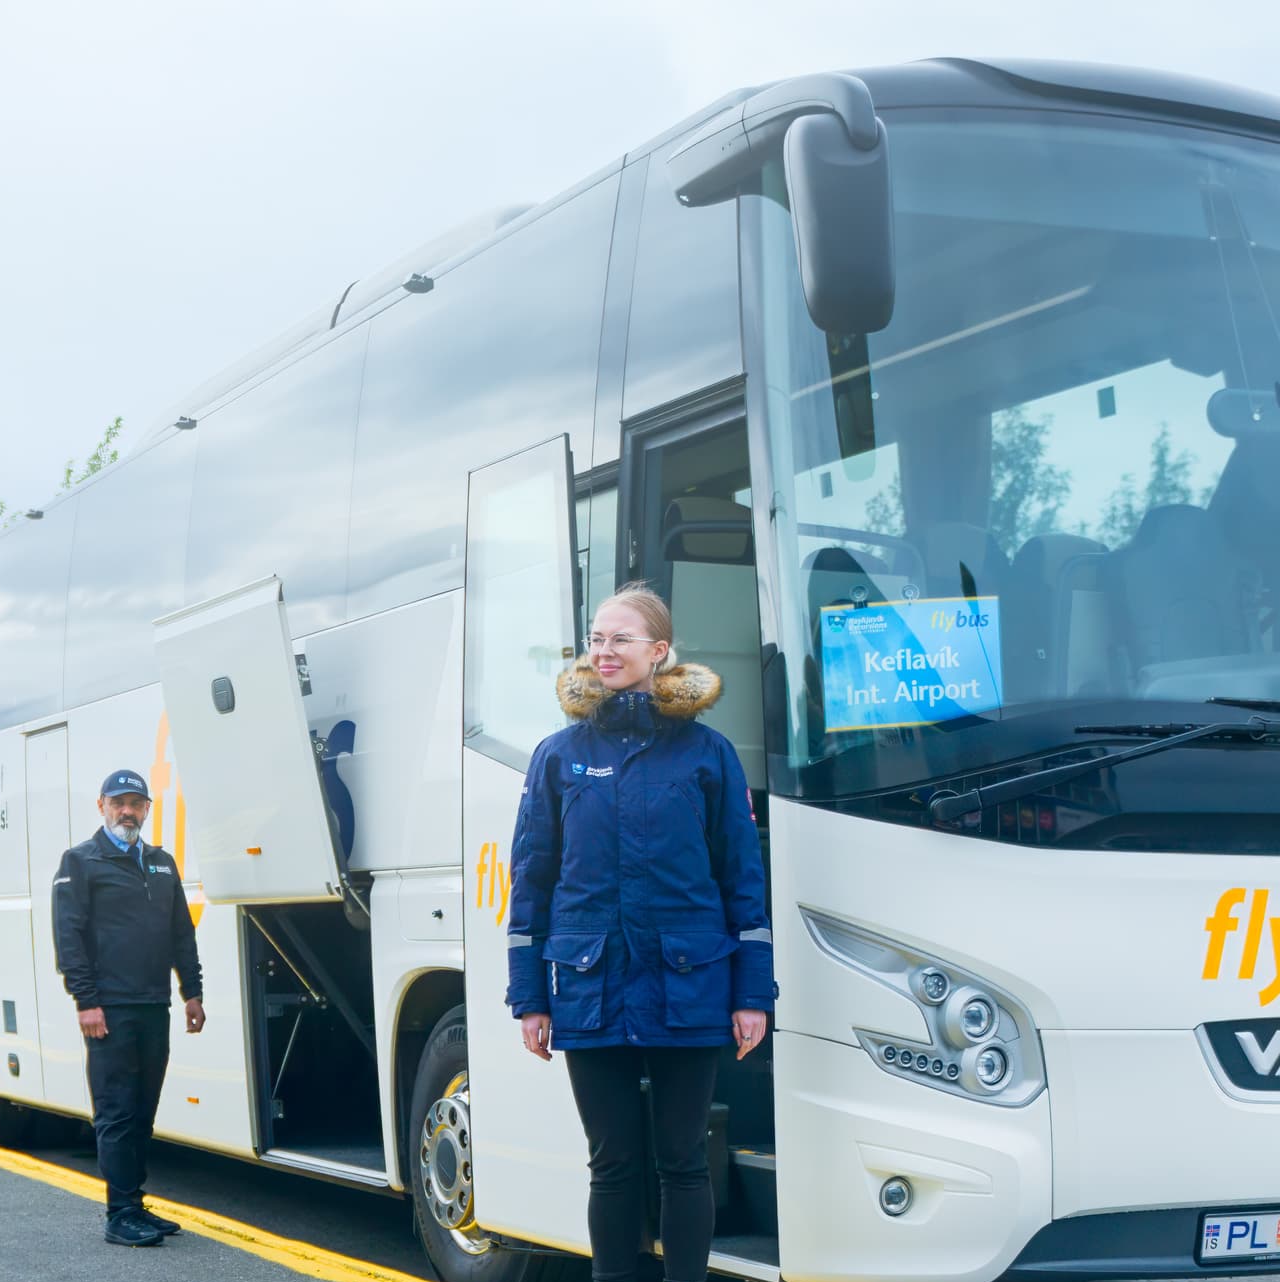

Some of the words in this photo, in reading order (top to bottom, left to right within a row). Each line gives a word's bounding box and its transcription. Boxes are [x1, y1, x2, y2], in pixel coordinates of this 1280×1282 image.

[931, 610, 989, 632] flybus
[864, 646, 960, 673] Keflavík
[847, 684, 886, 705] Int.
[894, 679, 982, 708] Airport
[476, 842, 511, 928] fly
[1205, 1238, 1218, 1250] IS
[1226, 1220, 1268, 1250] PL
